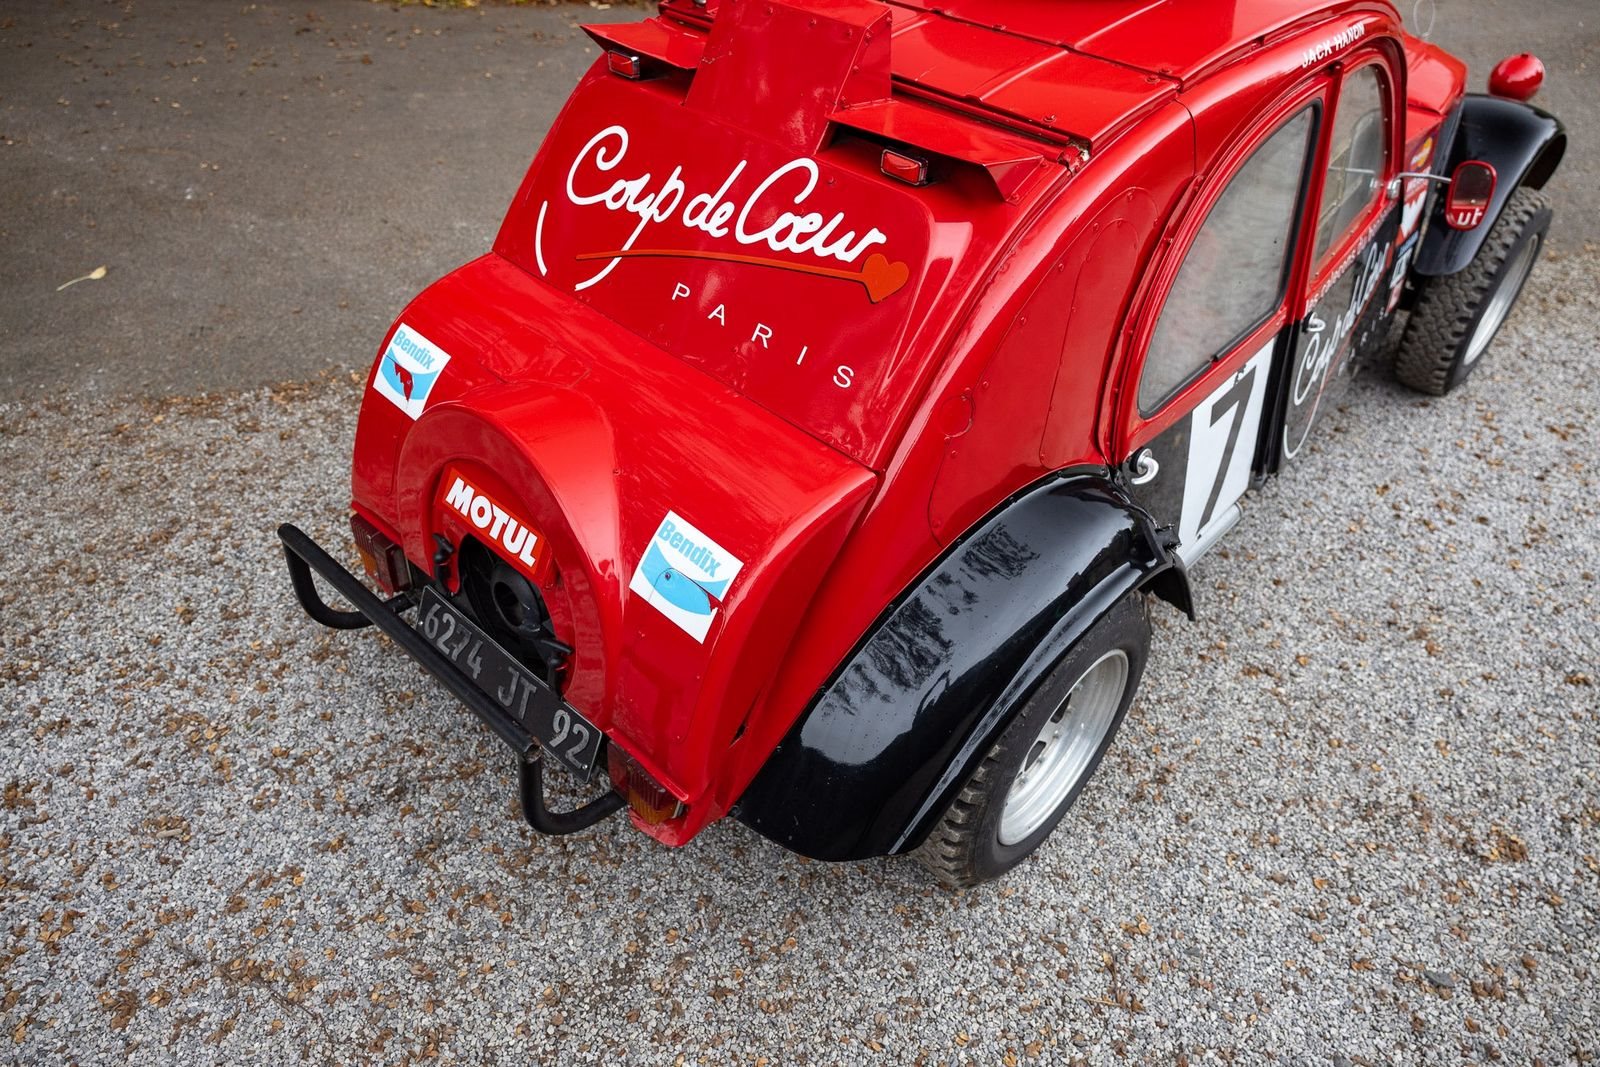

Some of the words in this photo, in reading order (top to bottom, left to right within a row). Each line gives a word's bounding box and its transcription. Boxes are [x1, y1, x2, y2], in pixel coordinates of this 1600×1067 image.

[1302, 39, 1333, 69] JACK
[1333, 21, 1365, 52] HANON
[566, 125, 685, 291] Coup
[682, 159, 748, 238] de
[392, 329, 436, 371] Bendix
[671, 281, 856, 389] PARIS
[1195, 364, 1257, 535] 7
[445, 476, 543, 569] MOTUL
[657, 518, 722, 576] Bendix
[424, 602, 484, 681] 6274
[497, 666, 538, 721] JT
[549, 708, 591, 770] 92
